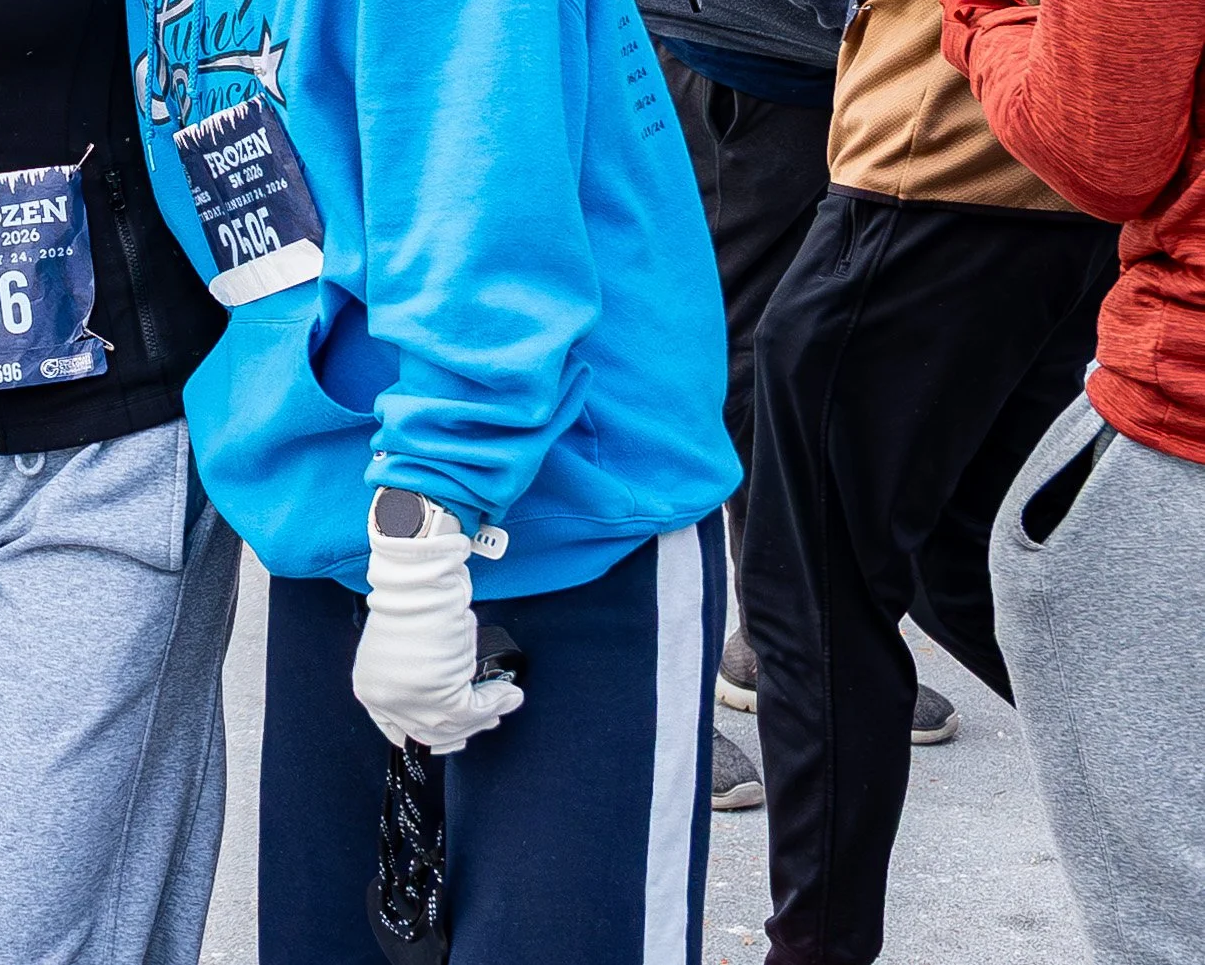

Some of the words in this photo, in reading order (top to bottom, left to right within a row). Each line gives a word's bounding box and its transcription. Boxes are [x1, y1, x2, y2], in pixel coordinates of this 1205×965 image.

[203, 126, 273, 179] FROZEN
[228, 174, 245, 189] 5K
[242, 163, 264, 183] 2026
[265, 177, 289, 195] 2026
[1, 227, 41, 247] 2026
[10, 250, 33, 264] 24,
[39, 246, 75, 259] 2026
